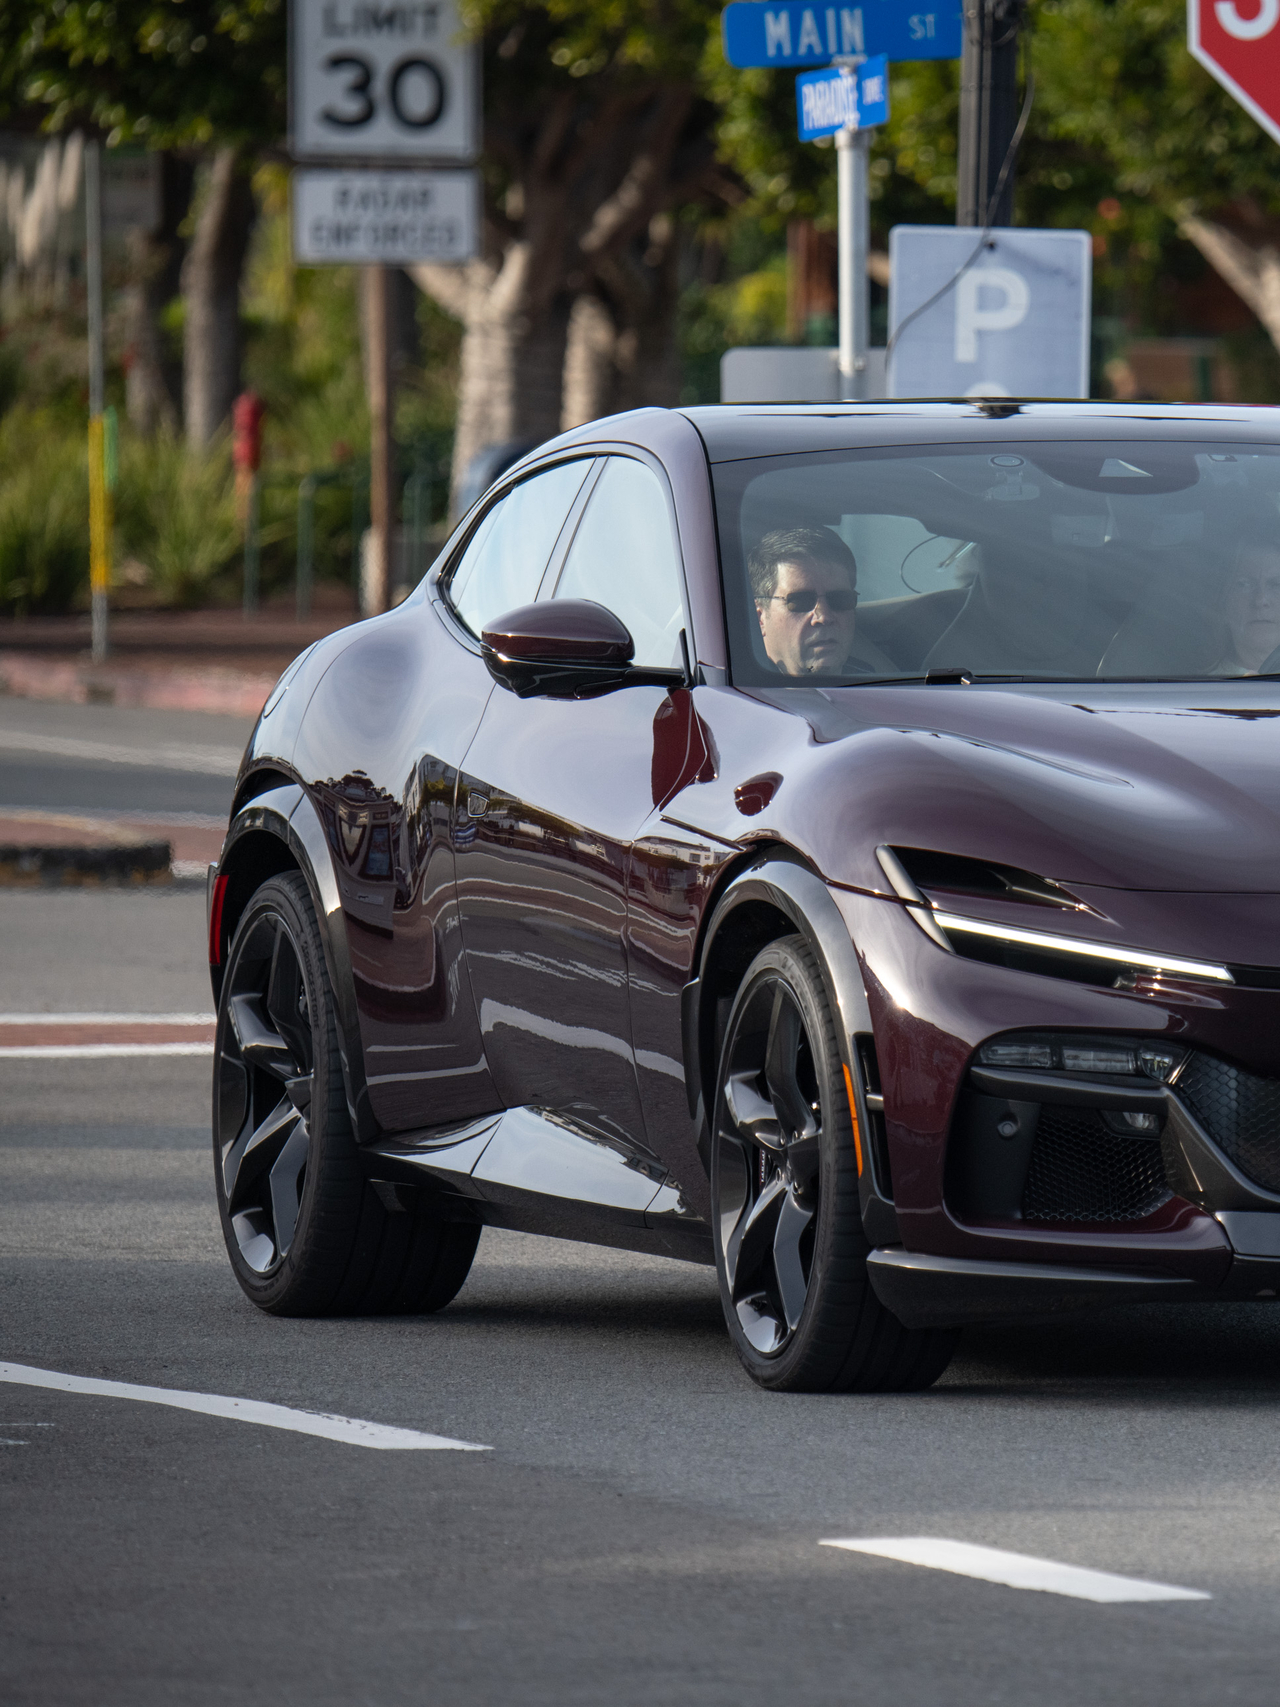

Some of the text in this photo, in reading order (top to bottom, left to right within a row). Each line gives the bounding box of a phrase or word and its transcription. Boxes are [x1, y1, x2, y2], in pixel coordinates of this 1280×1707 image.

[323, 2, 445, 40] LIMIT
[764, 8, 936, 57] MAIN ST
[321, 55, 446, 132] 30
[955, 267, 1030, 363] P
